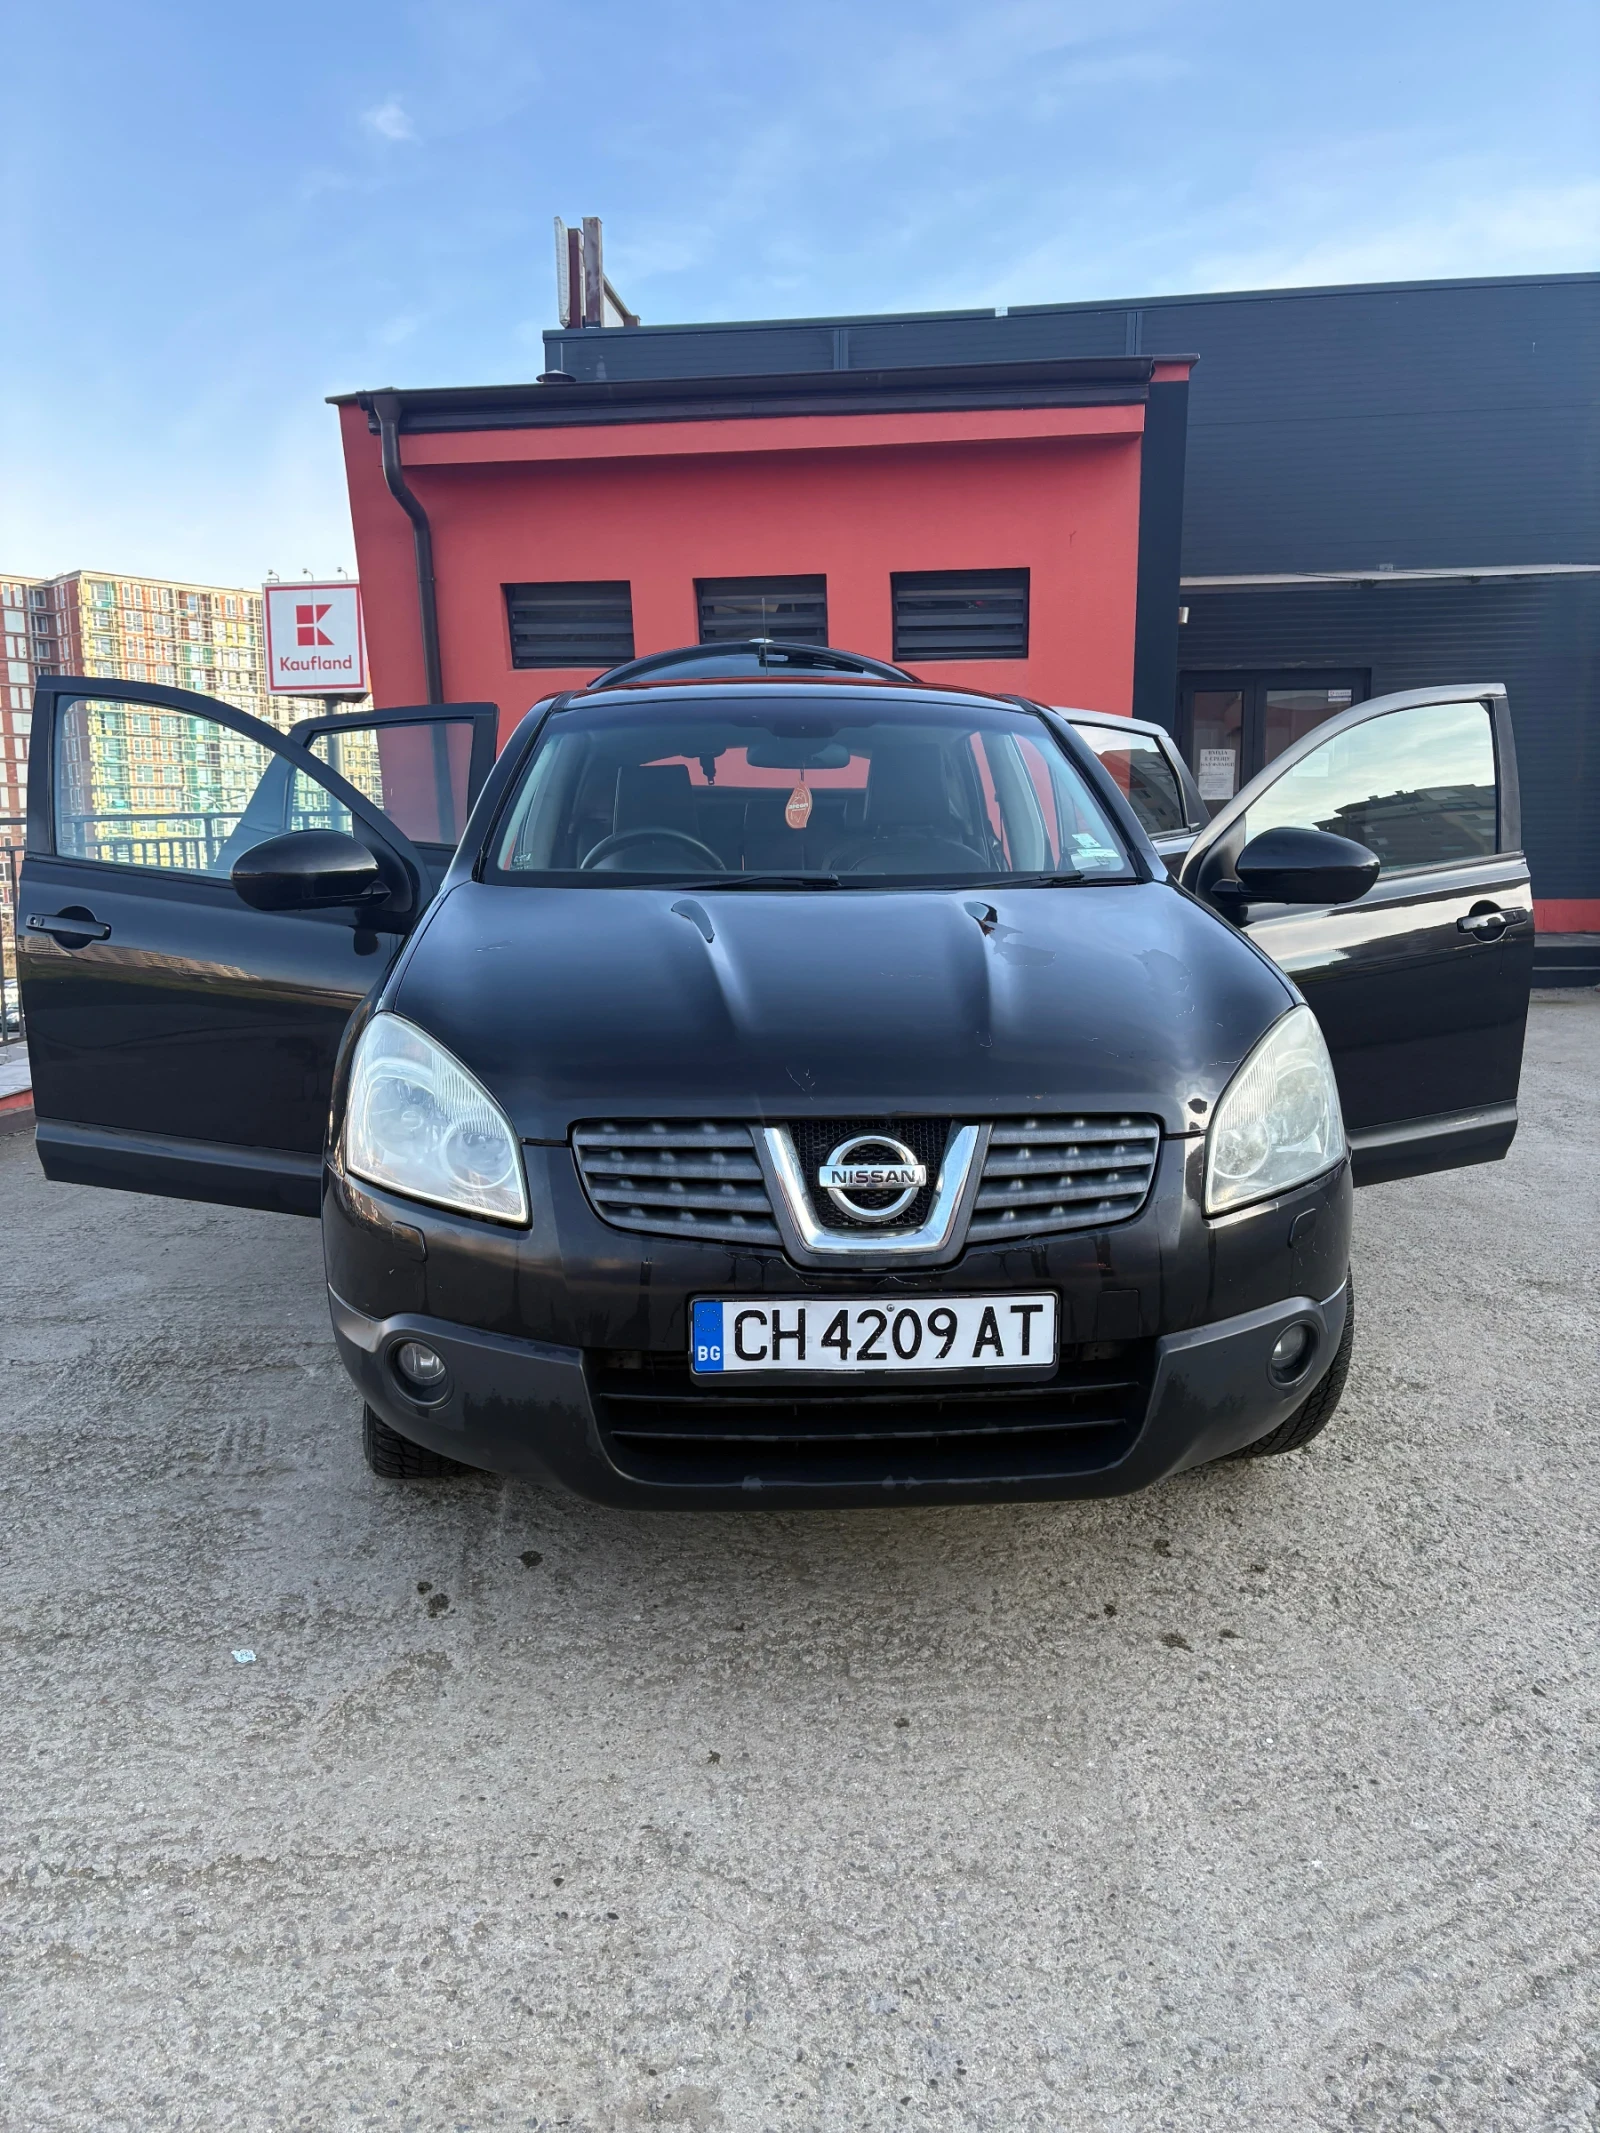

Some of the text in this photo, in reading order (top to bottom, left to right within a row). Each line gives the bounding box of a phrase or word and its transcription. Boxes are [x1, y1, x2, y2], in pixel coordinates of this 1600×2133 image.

[280, 654, 352, 671] Kaufland
[831, 1170, 916, 1184] NISSAN
[698, 1303, 1043, 1361] BG CH 4209 AT
